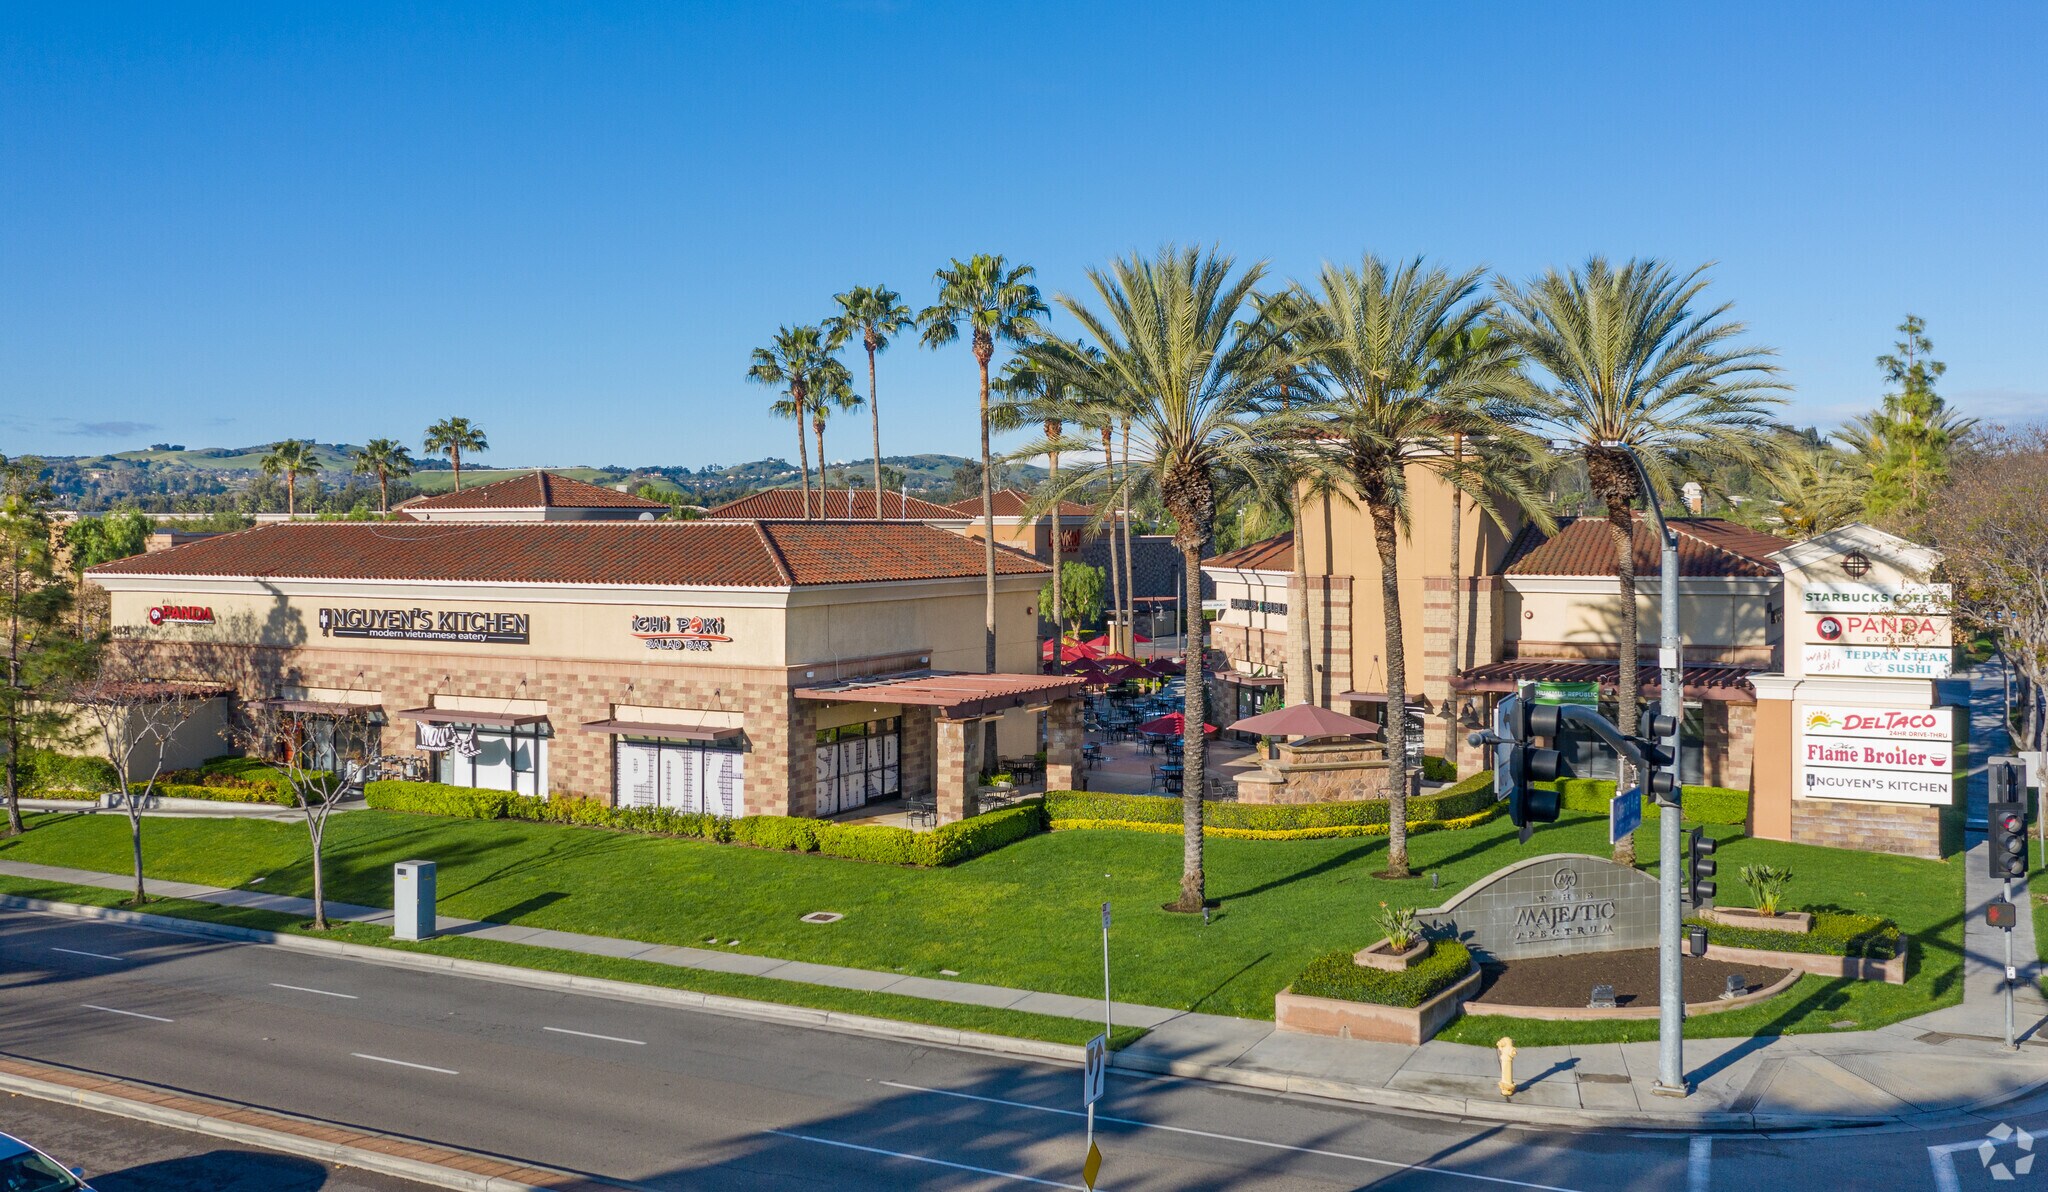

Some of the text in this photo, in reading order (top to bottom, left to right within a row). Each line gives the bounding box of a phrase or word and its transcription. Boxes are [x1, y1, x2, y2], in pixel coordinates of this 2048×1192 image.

[1805, 592, 1889, 603] STARBUCKS
[162, 605, 215, 620] PANDA
[332, 608, 529, 633] NGUYEN'S KITCHEN
[1847, 617, 1936, 635] PANDA
[369, 629, 487, 642] modern vietnamese eatery
[645, 639, 712, 651] SALAD BAR
[1845, 650, 1949, 662] TEPPAN STEAK
[1887, 664, 1931, 674] SUSHI
[1909, 731, 1948, 739] DRIVE-THRU
[815, 734, 898, 781] SALAD
[1807, 744, 1926, 766] Flame Broiler
[1816, 776, 1948, 793] NGUYEN'S KITCHEN
[815, 773, 866, 816] BAR
[1514, 901, 1616, 929] MAJESTIC
[1516, 924, 1614, 940] SPECTRUM
